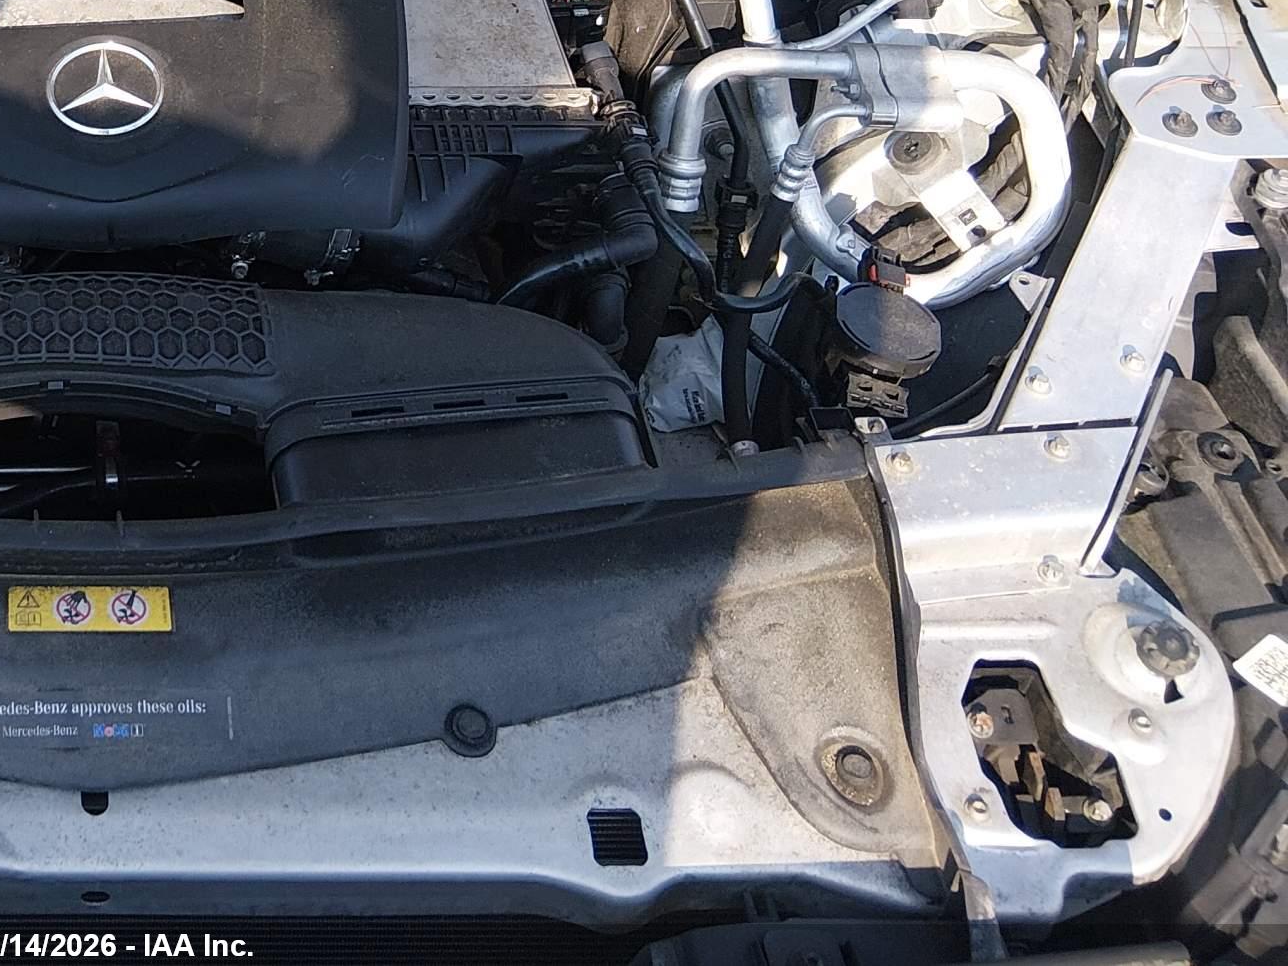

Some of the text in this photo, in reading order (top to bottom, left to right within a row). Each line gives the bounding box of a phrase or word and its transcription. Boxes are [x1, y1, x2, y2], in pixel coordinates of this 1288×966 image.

[71, 702, 133, 717] approves
[137, 699, 174, 714] these
[177, 699, 207, 714] oils:
[2, 724, 78, 738] Mercedes-Benz
